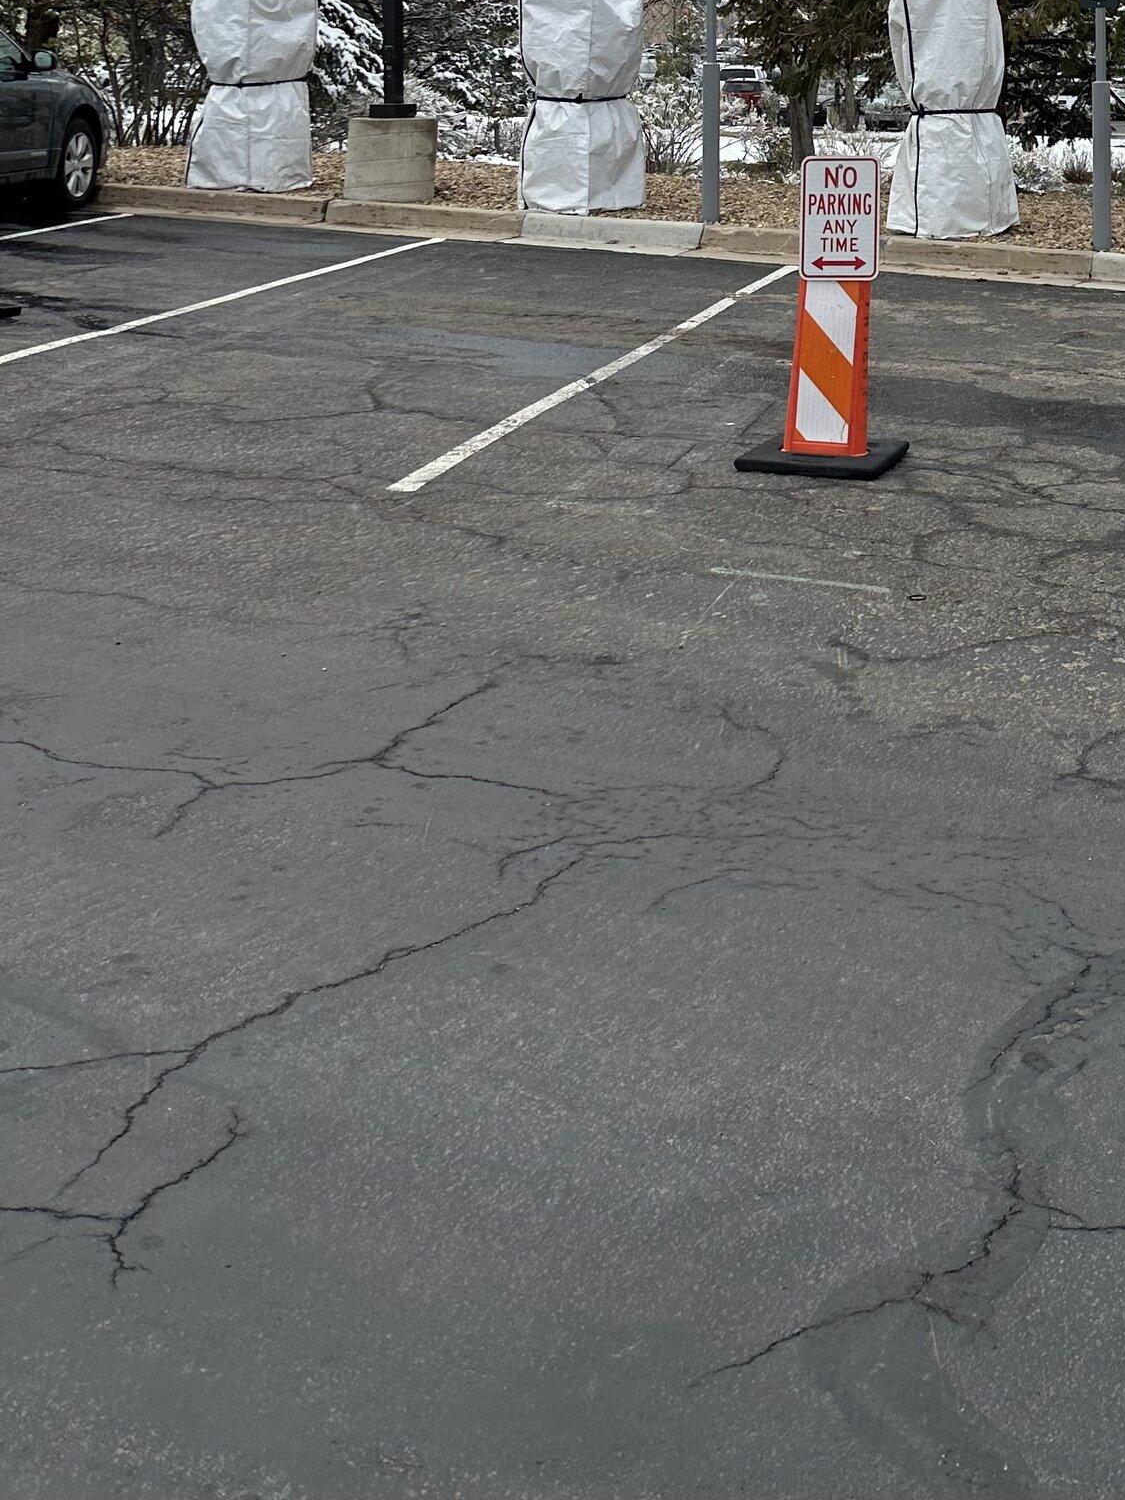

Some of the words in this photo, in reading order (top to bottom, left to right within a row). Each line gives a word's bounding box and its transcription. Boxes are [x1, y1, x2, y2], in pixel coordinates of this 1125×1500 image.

[824, 166, 858, 189] NO
[808, 193, 872, 216] PARKING
[822, 219, 858, 235] ANY
[820, 237, 859, 253] TIME
